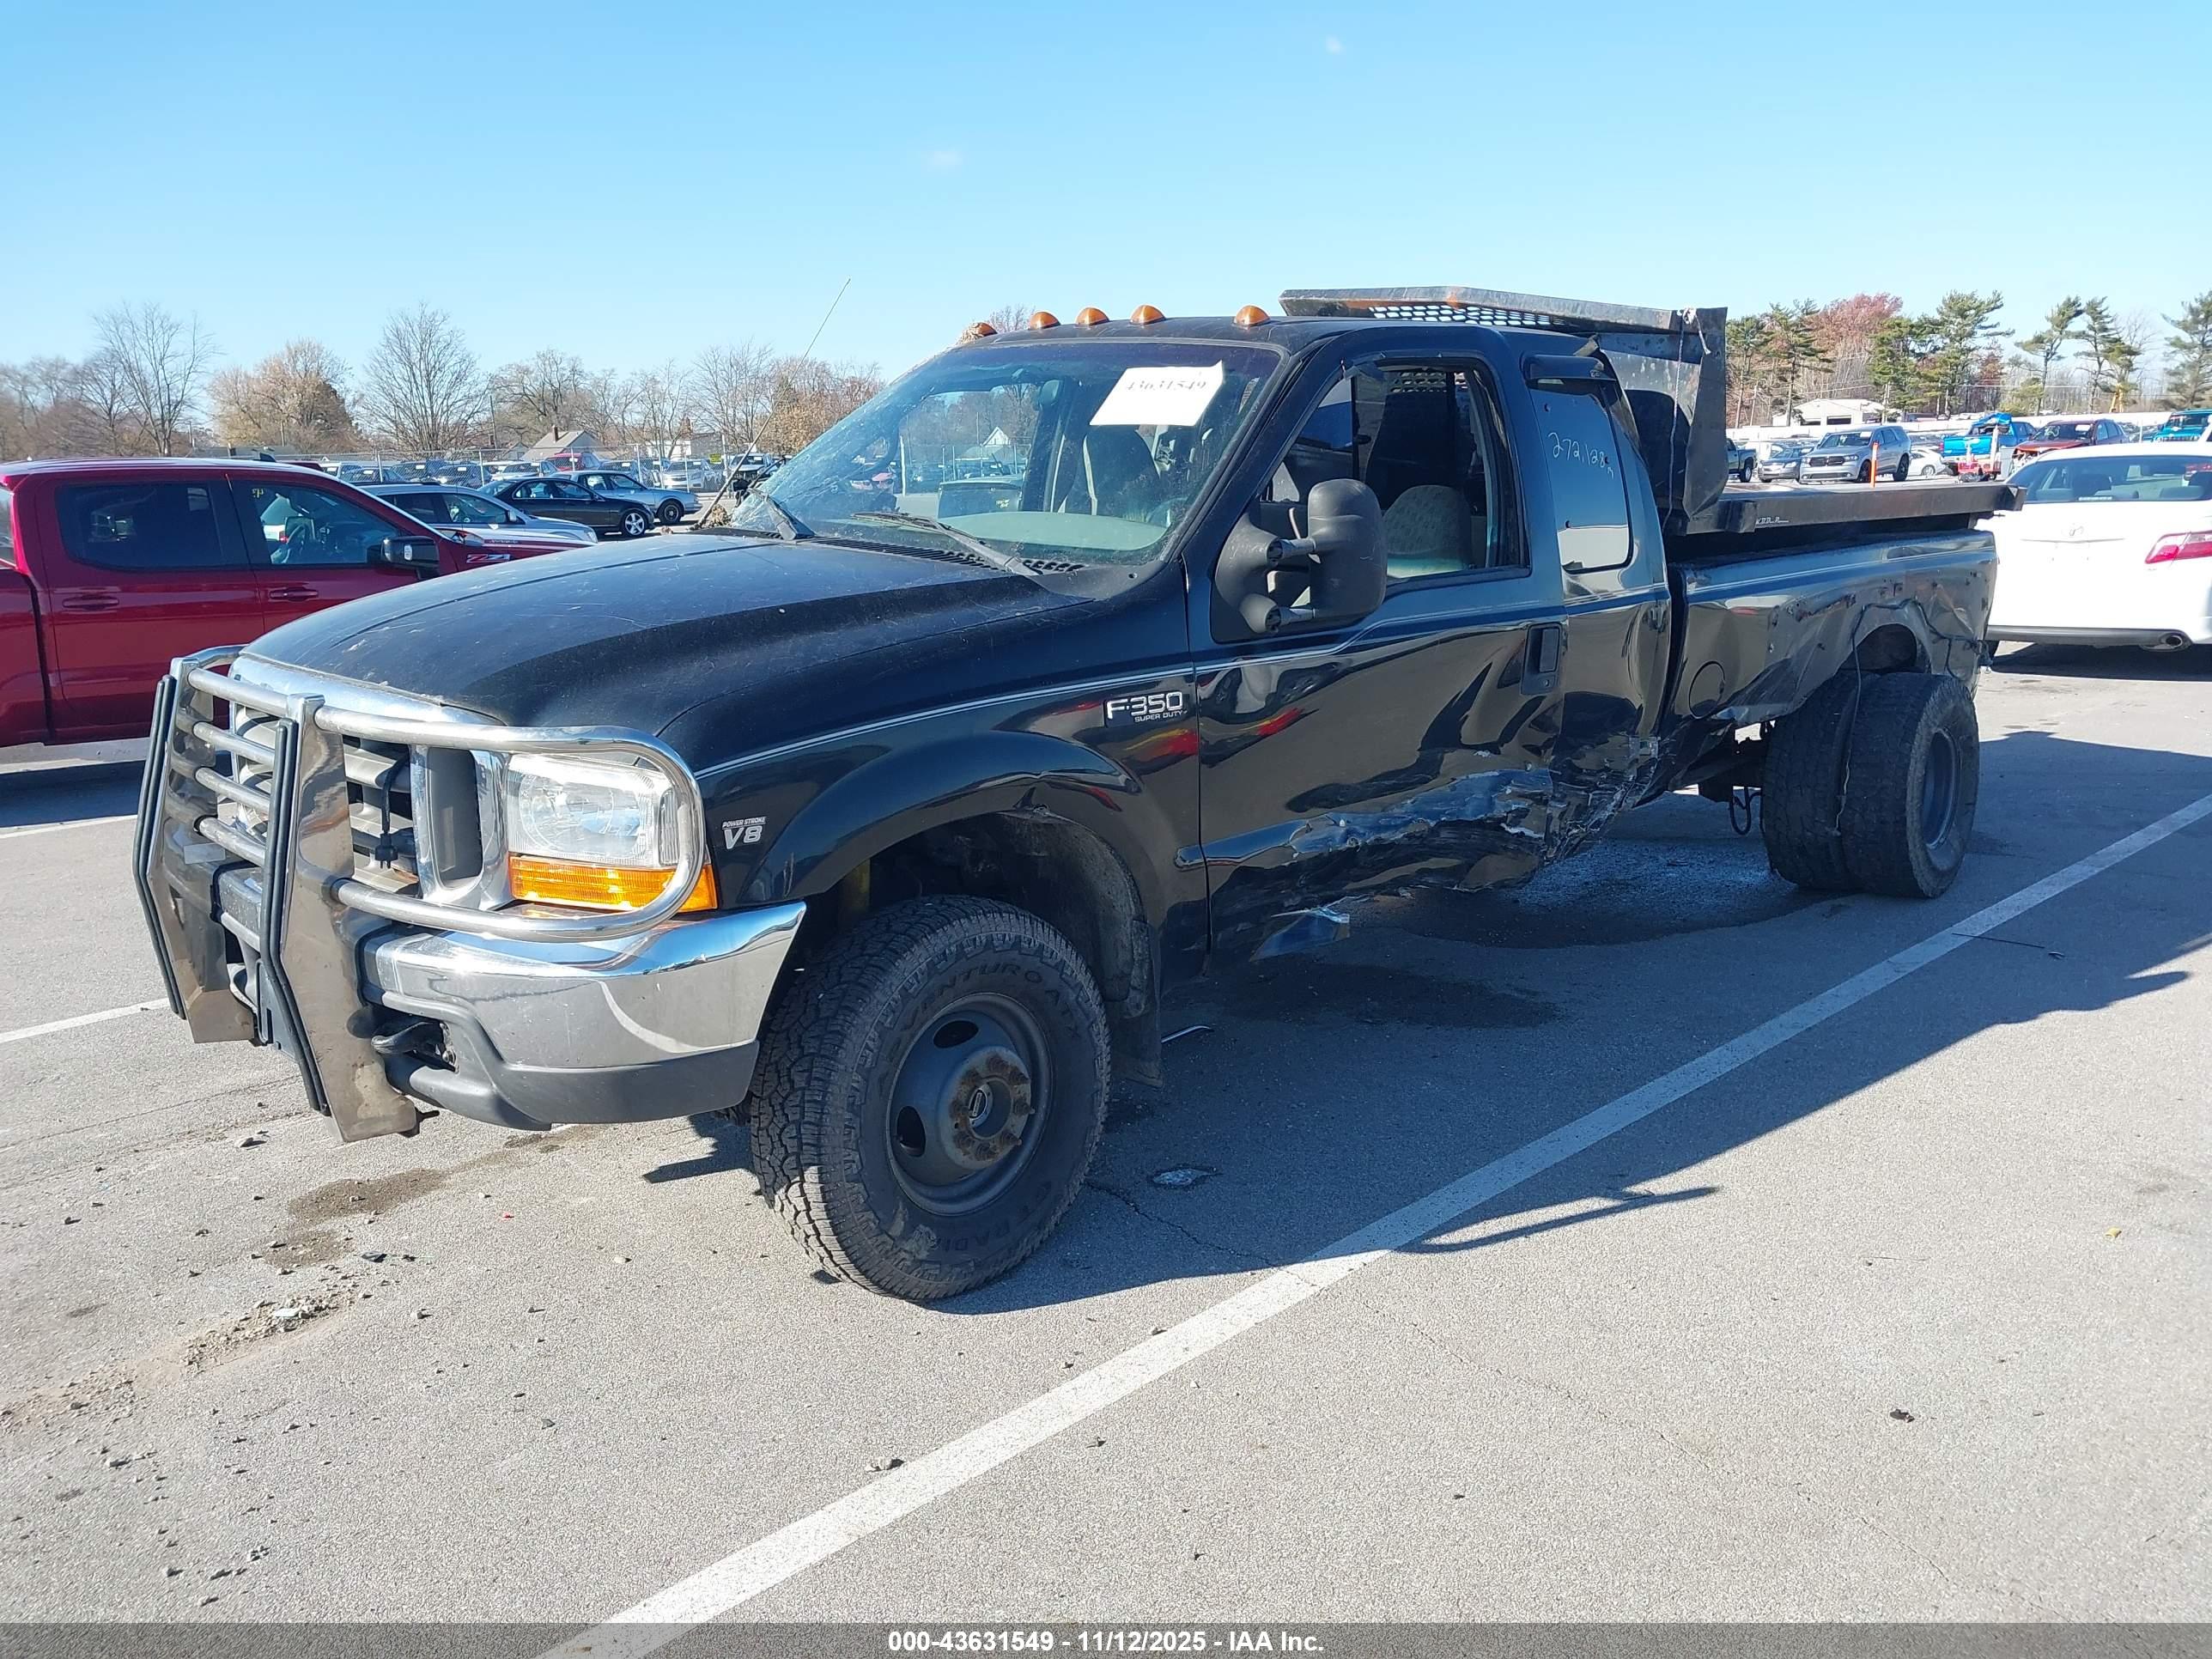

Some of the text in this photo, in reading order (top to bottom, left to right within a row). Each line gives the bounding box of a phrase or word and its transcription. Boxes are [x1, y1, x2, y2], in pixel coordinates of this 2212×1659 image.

[1134, 709, 1183, 723] SUPER DUTY
[722, 817, 767, 828] POWER STROKE
[724, 825, 763, 849] V8
